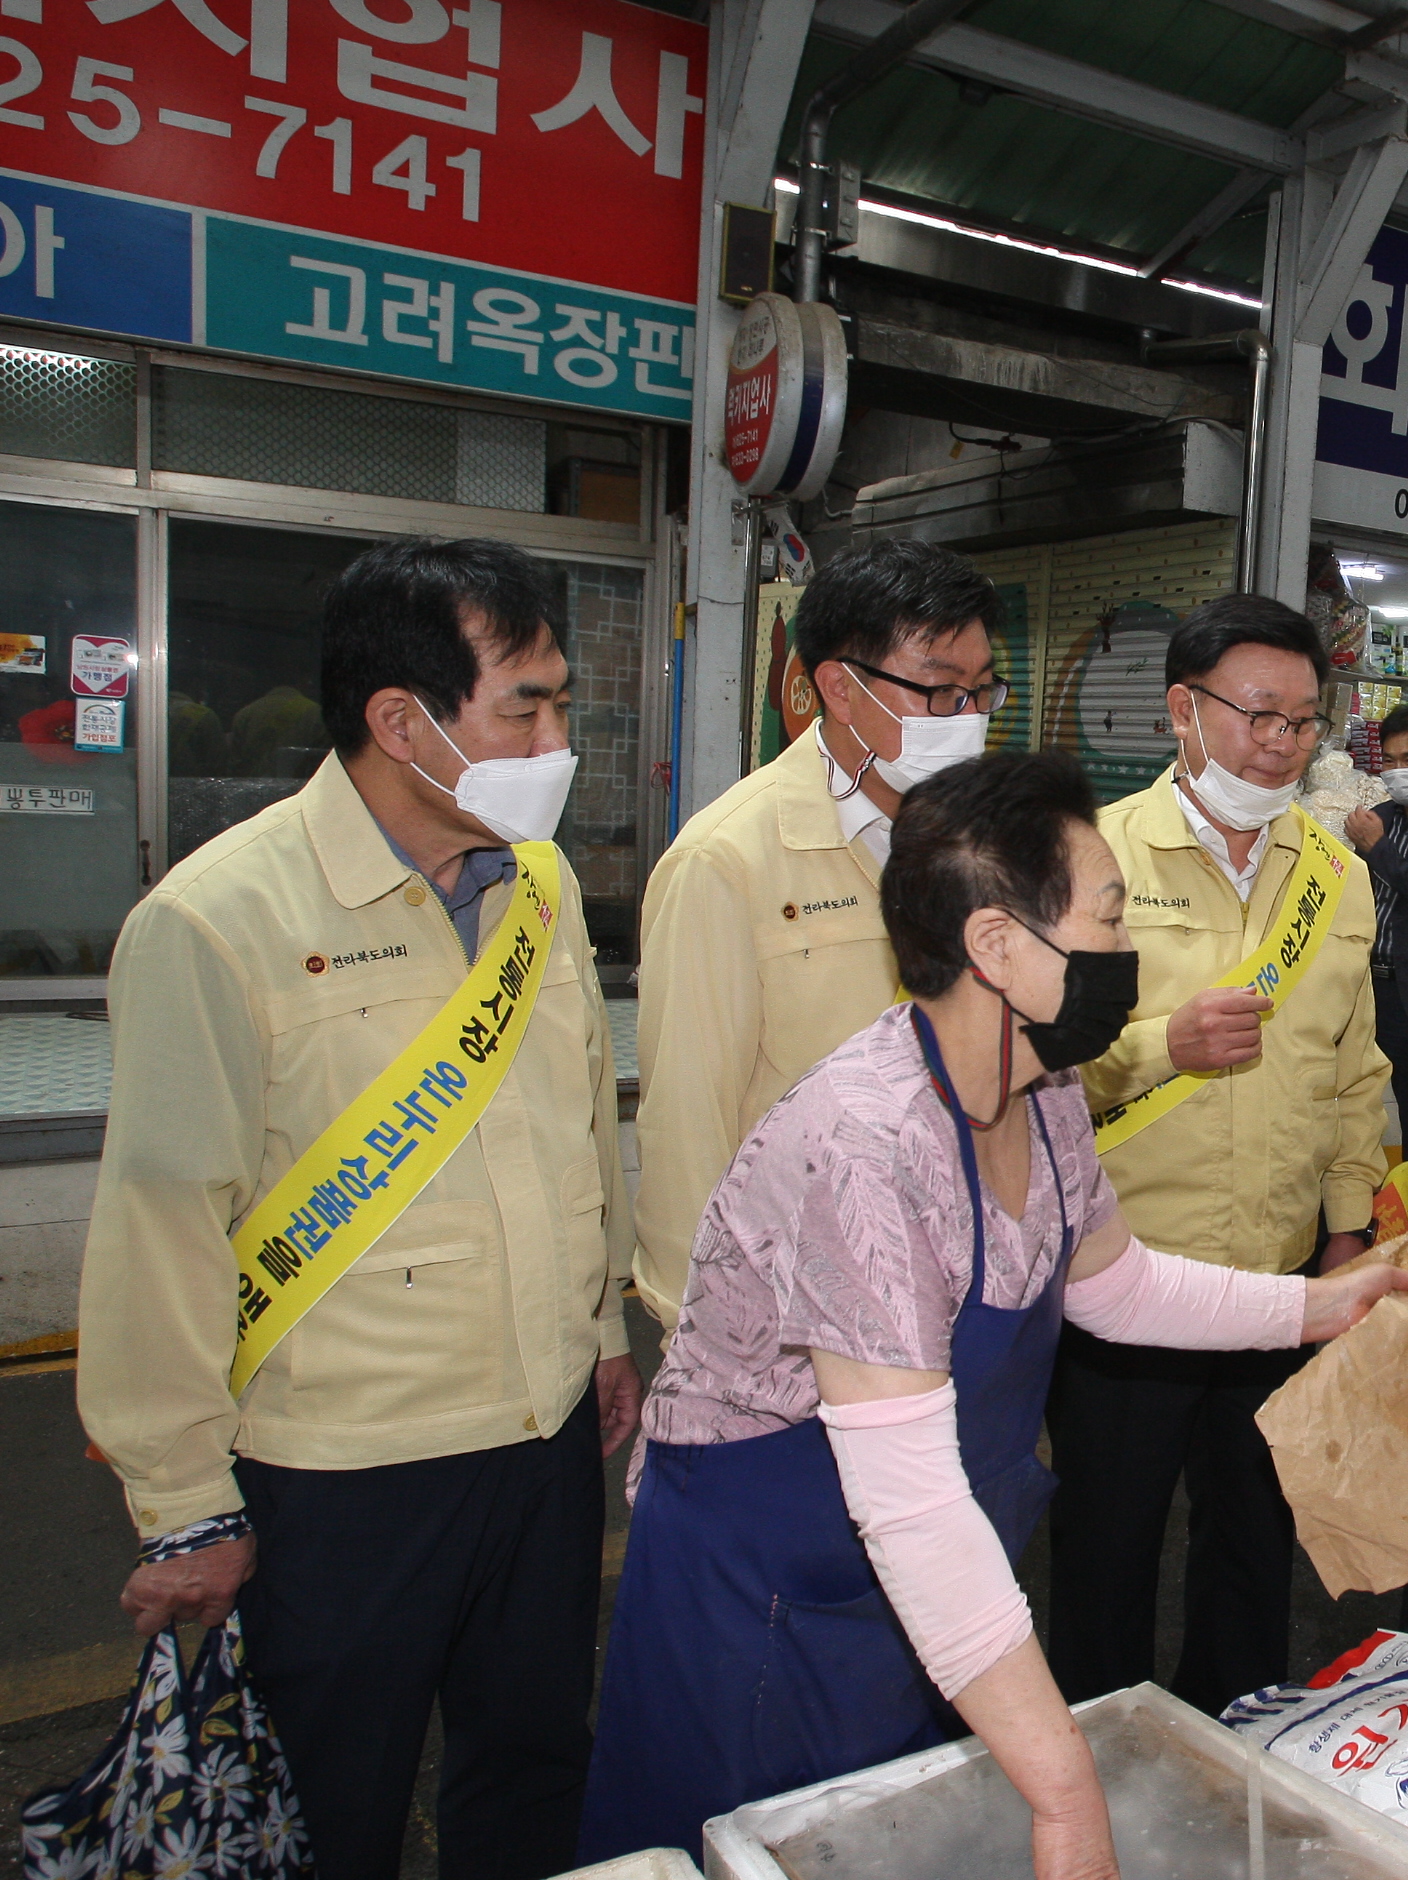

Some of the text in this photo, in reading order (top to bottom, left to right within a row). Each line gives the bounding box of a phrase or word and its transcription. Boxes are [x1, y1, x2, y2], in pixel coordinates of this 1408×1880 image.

[285, 254, 696, 400] 고려옥장판
[727, 372, 772, 427] 럭키지업사
[82, 732, 117, 743] 가입점포
[802, 895, 859, 915] 전라북도의회
[1131, 894, 1191, 909] 전라북도의회
[1280, 874, 1327, 969] 전통시장
[330, 943, 408, 970] 전라북도의회
[459, 924, 537, 1064] 전통시장
[256, 1059, 470, 1287] 온누리상품권을
